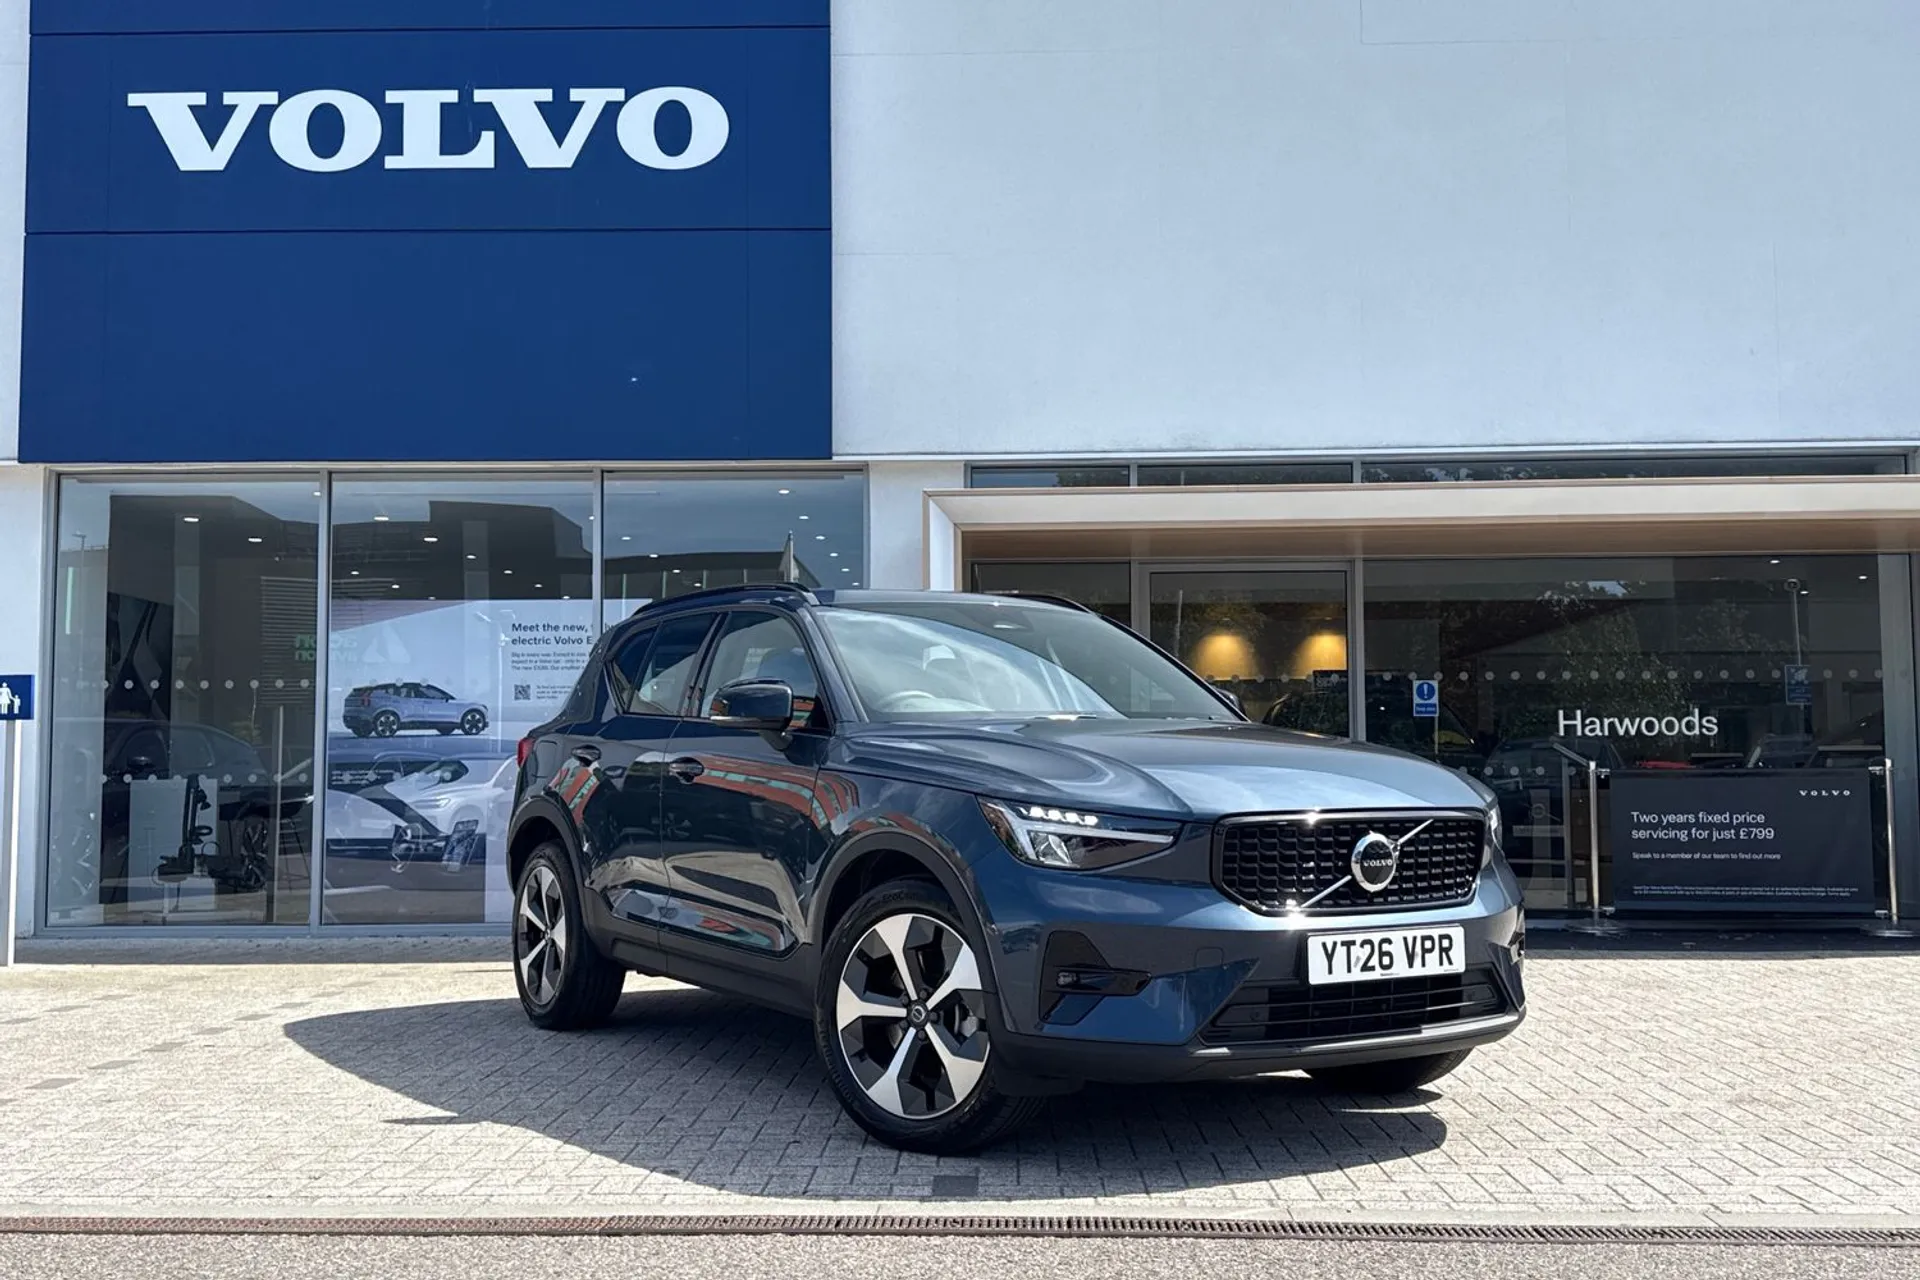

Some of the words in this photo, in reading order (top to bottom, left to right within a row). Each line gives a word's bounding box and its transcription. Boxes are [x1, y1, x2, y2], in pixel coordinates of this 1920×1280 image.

[127, 86, 730, 172] VOLVO
[511, 623, 539, 632] Meet
[542, 623, 560, 632] the
[562, 624, 588, 633] new,
[511, 636, 551, 645] electric
[554, 636, 583, 645] Volvo
[1557, 708, 1719, 736] Harwoods
[1630, 811, 1659, 823] Two
[1661, 813, 1696, 826] years
[1698, 811, 1730, 823] fixed
[1733, 811, 1765, 826] price
[1631, 827, 1689, 842] servicing
[1691, 827, 1710, 839] for
[1712, 827, 1736, 842] just
[1740, 827, 1775, 839] £799
[1363, 859, 1393, 867] VOLVO
[1632, 852, 1652, 860] Speak
[1321, 937, 1394, 975] YT26
[1403, 933, 1453, 969] VPR
